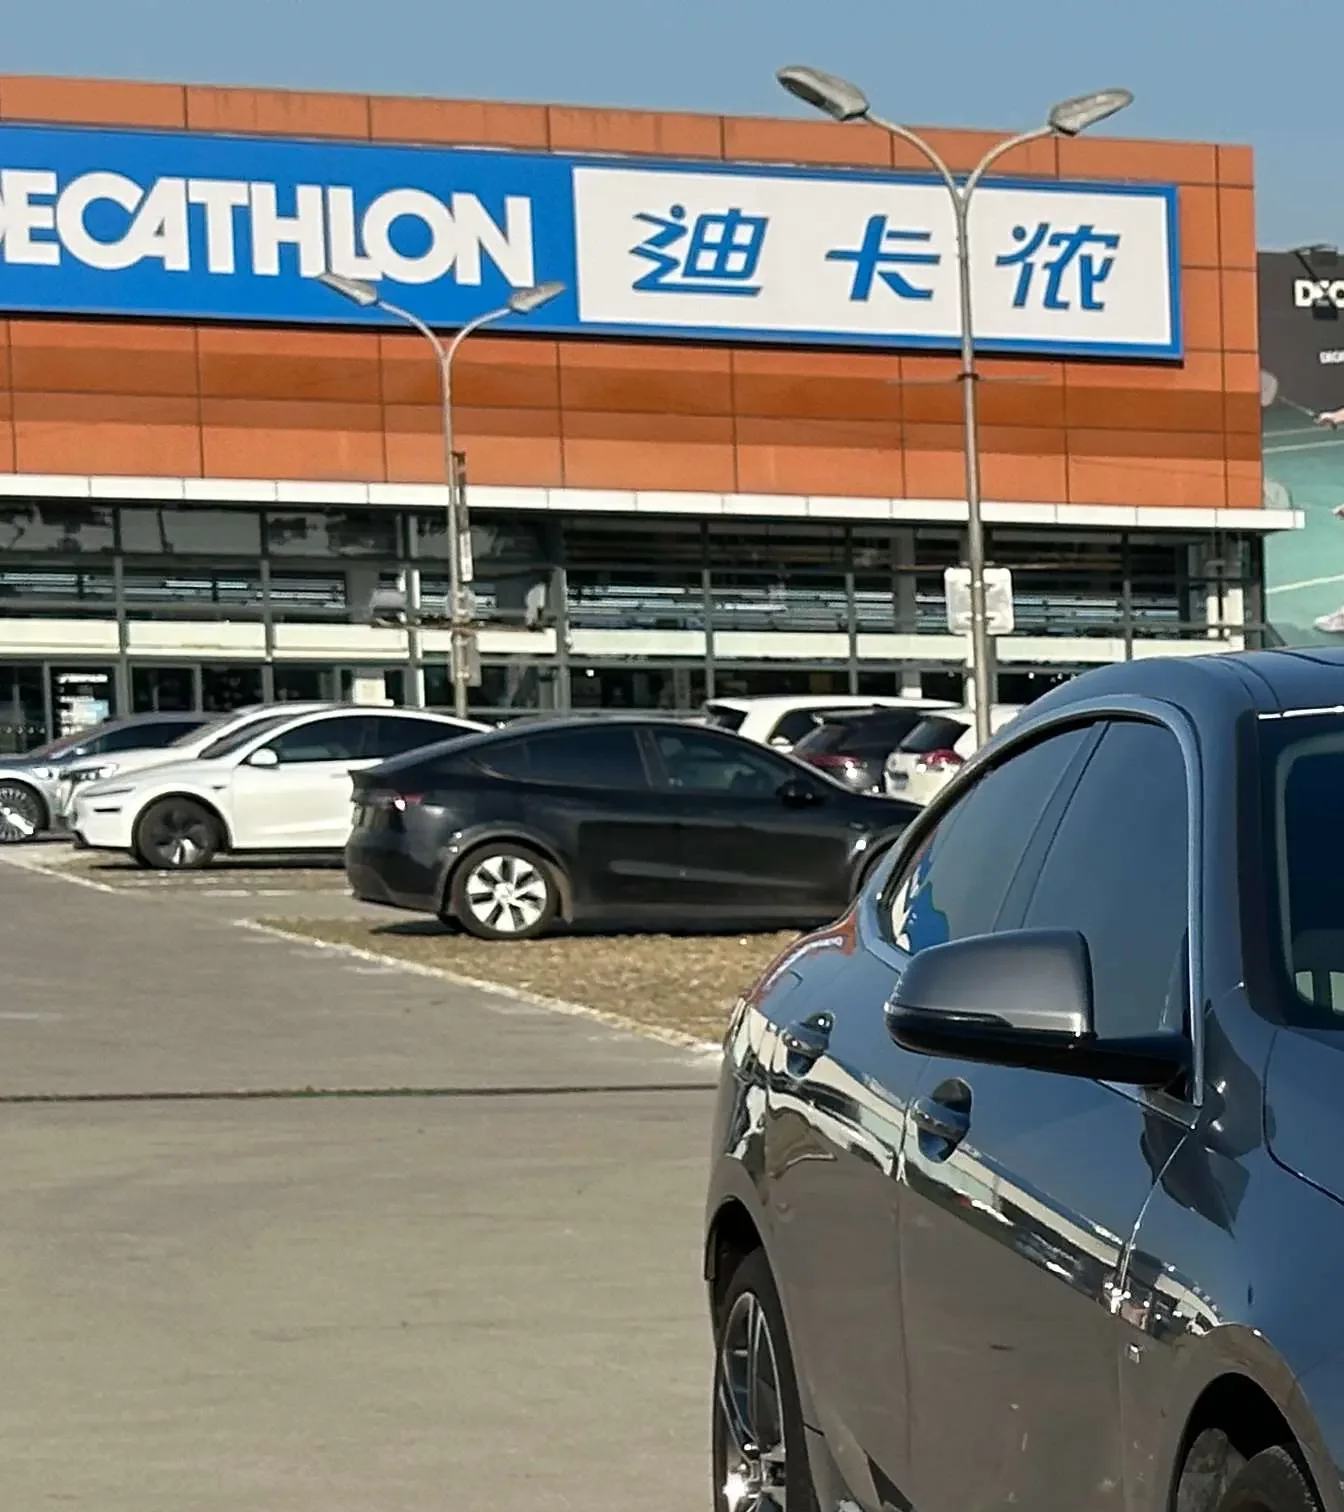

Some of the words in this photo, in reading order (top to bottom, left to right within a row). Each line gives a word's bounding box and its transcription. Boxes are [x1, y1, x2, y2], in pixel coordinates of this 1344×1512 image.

[0, 168, 535, 288] ECATHLON
[628, 204, 1121, 312] 迪卡侬
